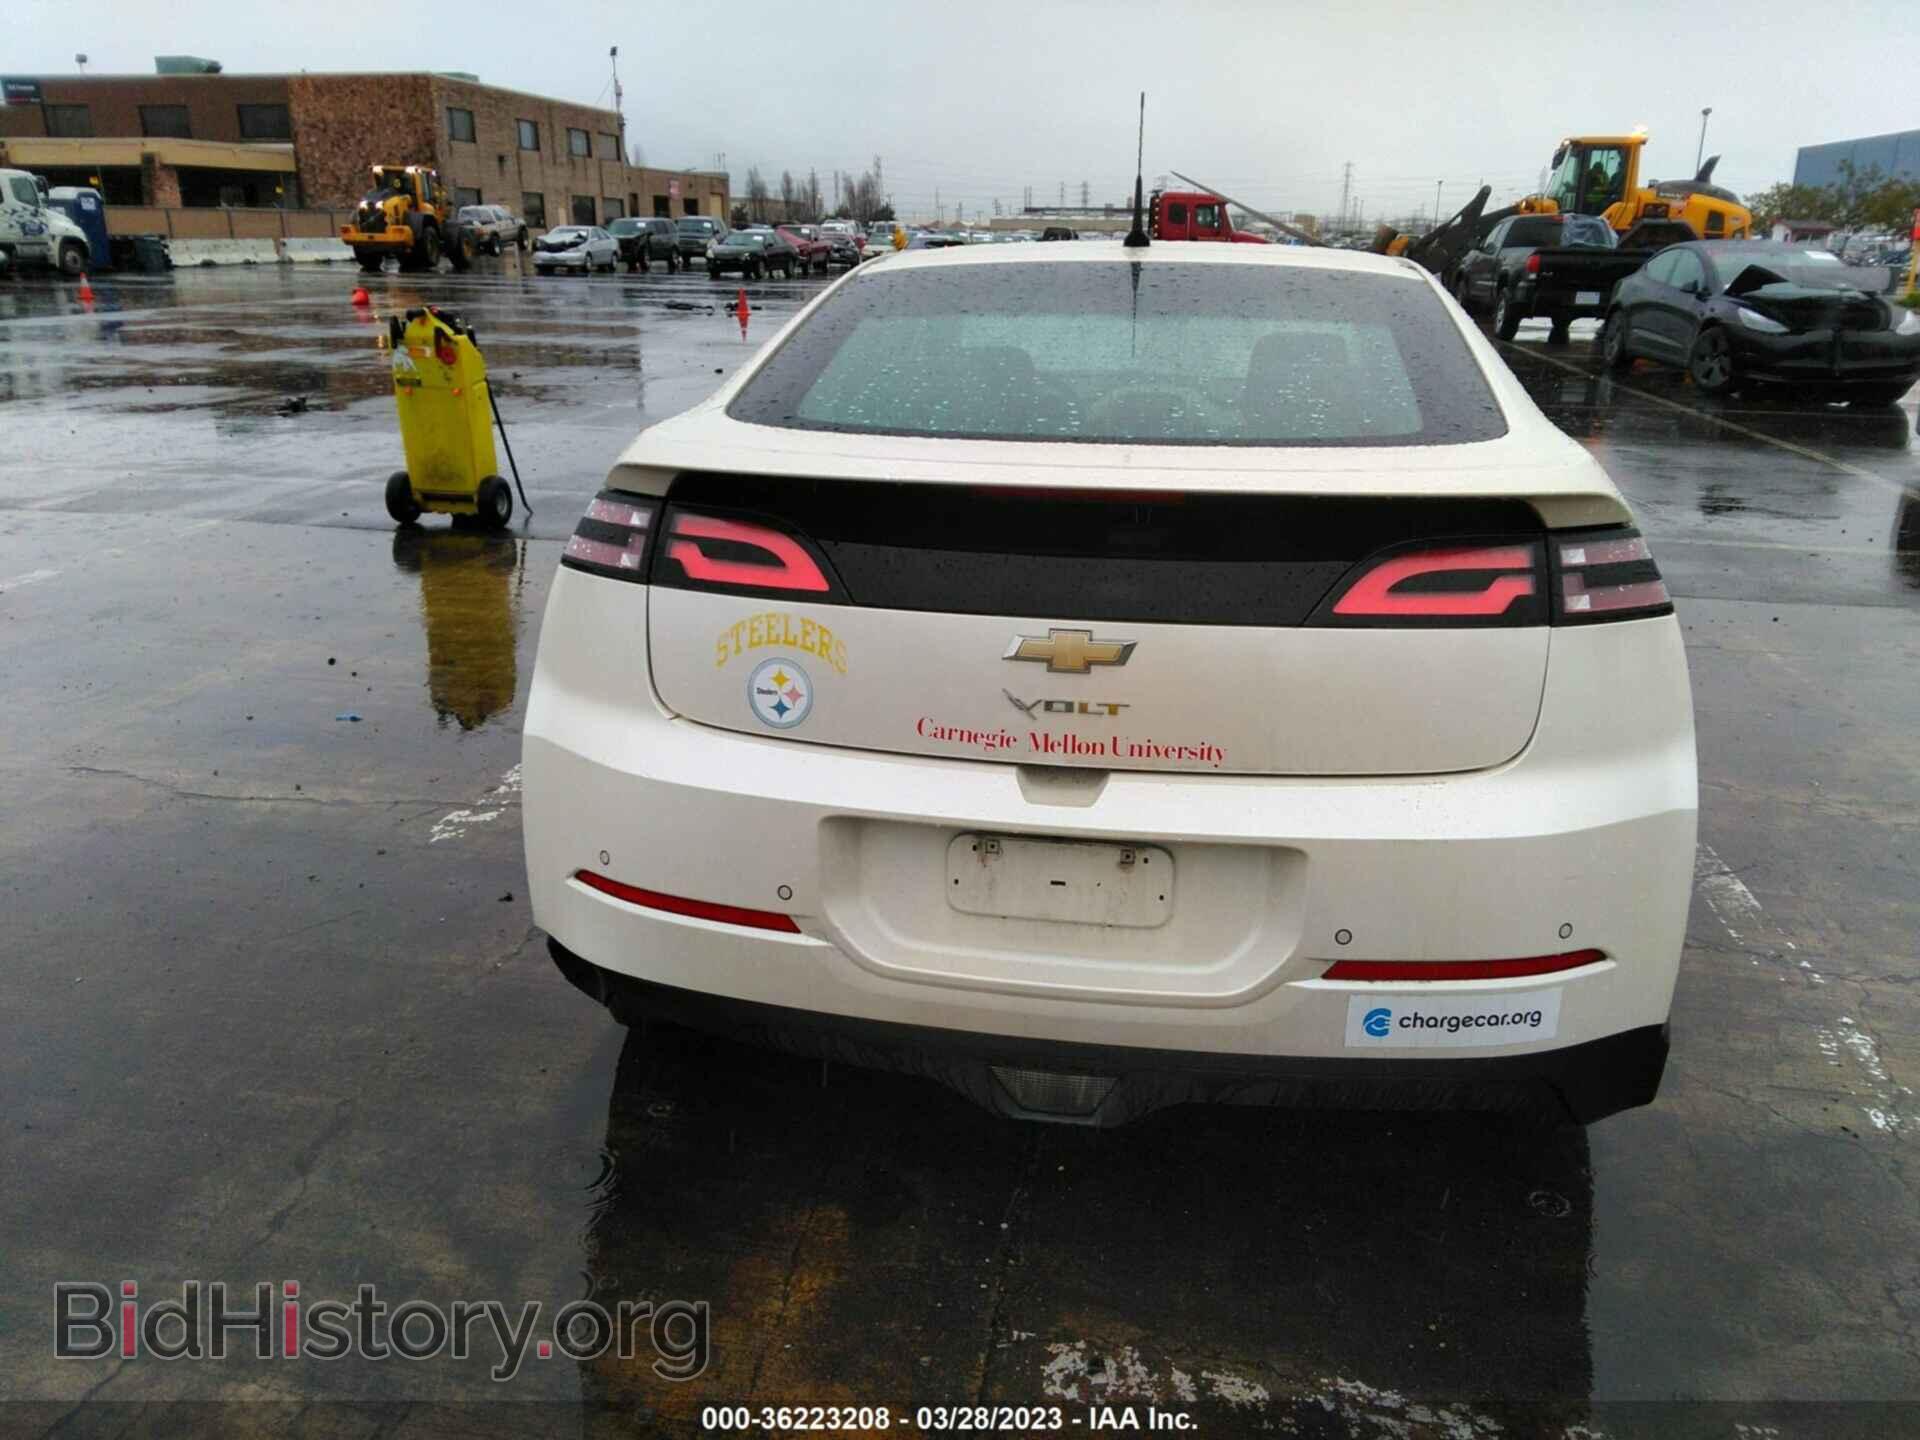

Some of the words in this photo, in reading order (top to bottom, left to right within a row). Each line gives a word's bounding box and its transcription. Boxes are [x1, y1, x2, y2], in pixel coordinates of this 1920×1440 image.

[714, 611, 848, 674] STEELERS
[1002, 688, 1130, 720] VOLT
[916, 717, 1017, 749] Carnegie
[1029, 731, 1105, 756] Mellon
[1111, 735, 1226, 768] University
[1399, 1009, 1542, 1033] chargecar.org
